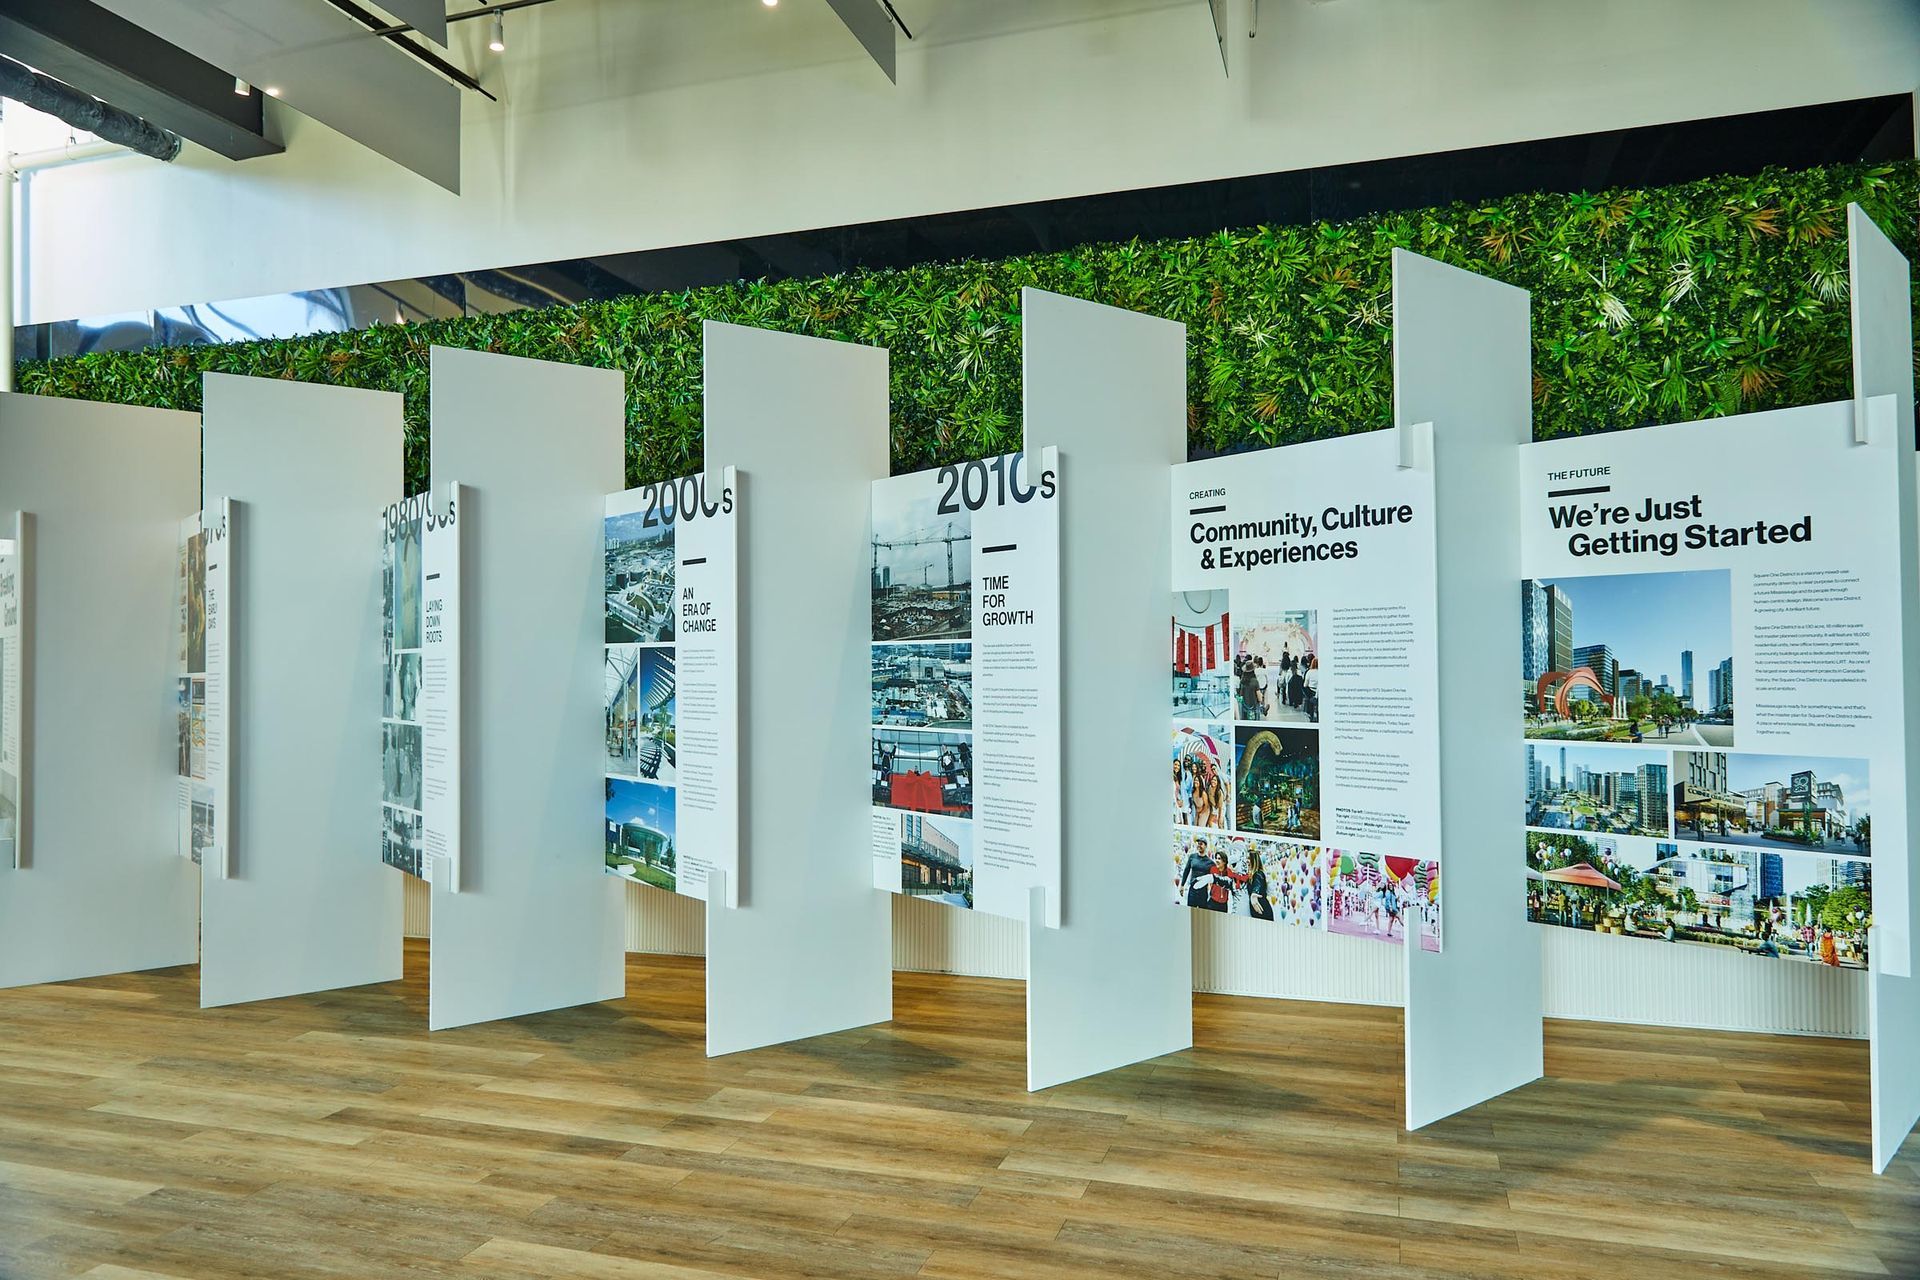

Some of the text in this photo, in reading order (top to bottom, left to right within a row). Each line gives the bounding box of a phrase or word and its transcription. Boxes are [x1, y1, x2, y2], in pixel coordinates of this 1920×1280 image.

[1548, 466, 1611, 480] THE FUTURE
[937, 452, 1055, 515] 2010s
[643, 473, 732, 528] 2000s
[1189, 488, 1226, 500] CREATING
[1548, 495, 1702, 529] We're Just
[1190, 504, 1413, 544] Community, Culture
[1568, 516, 1812, 557] Getting Started
[1200, 540, 1358, 571] & Experiences
[982, 575, 1009, 590] TIME
[683, 587, 694, 600] AN
[982, 594, 1005, 608] FOR
[683, 602, 711, 616] ERA OF
[982, 610, 1033, 626] GROWTH
[682, 619, 716, 633] CHANGE
[426, 631, 442, 643] ROOTS
